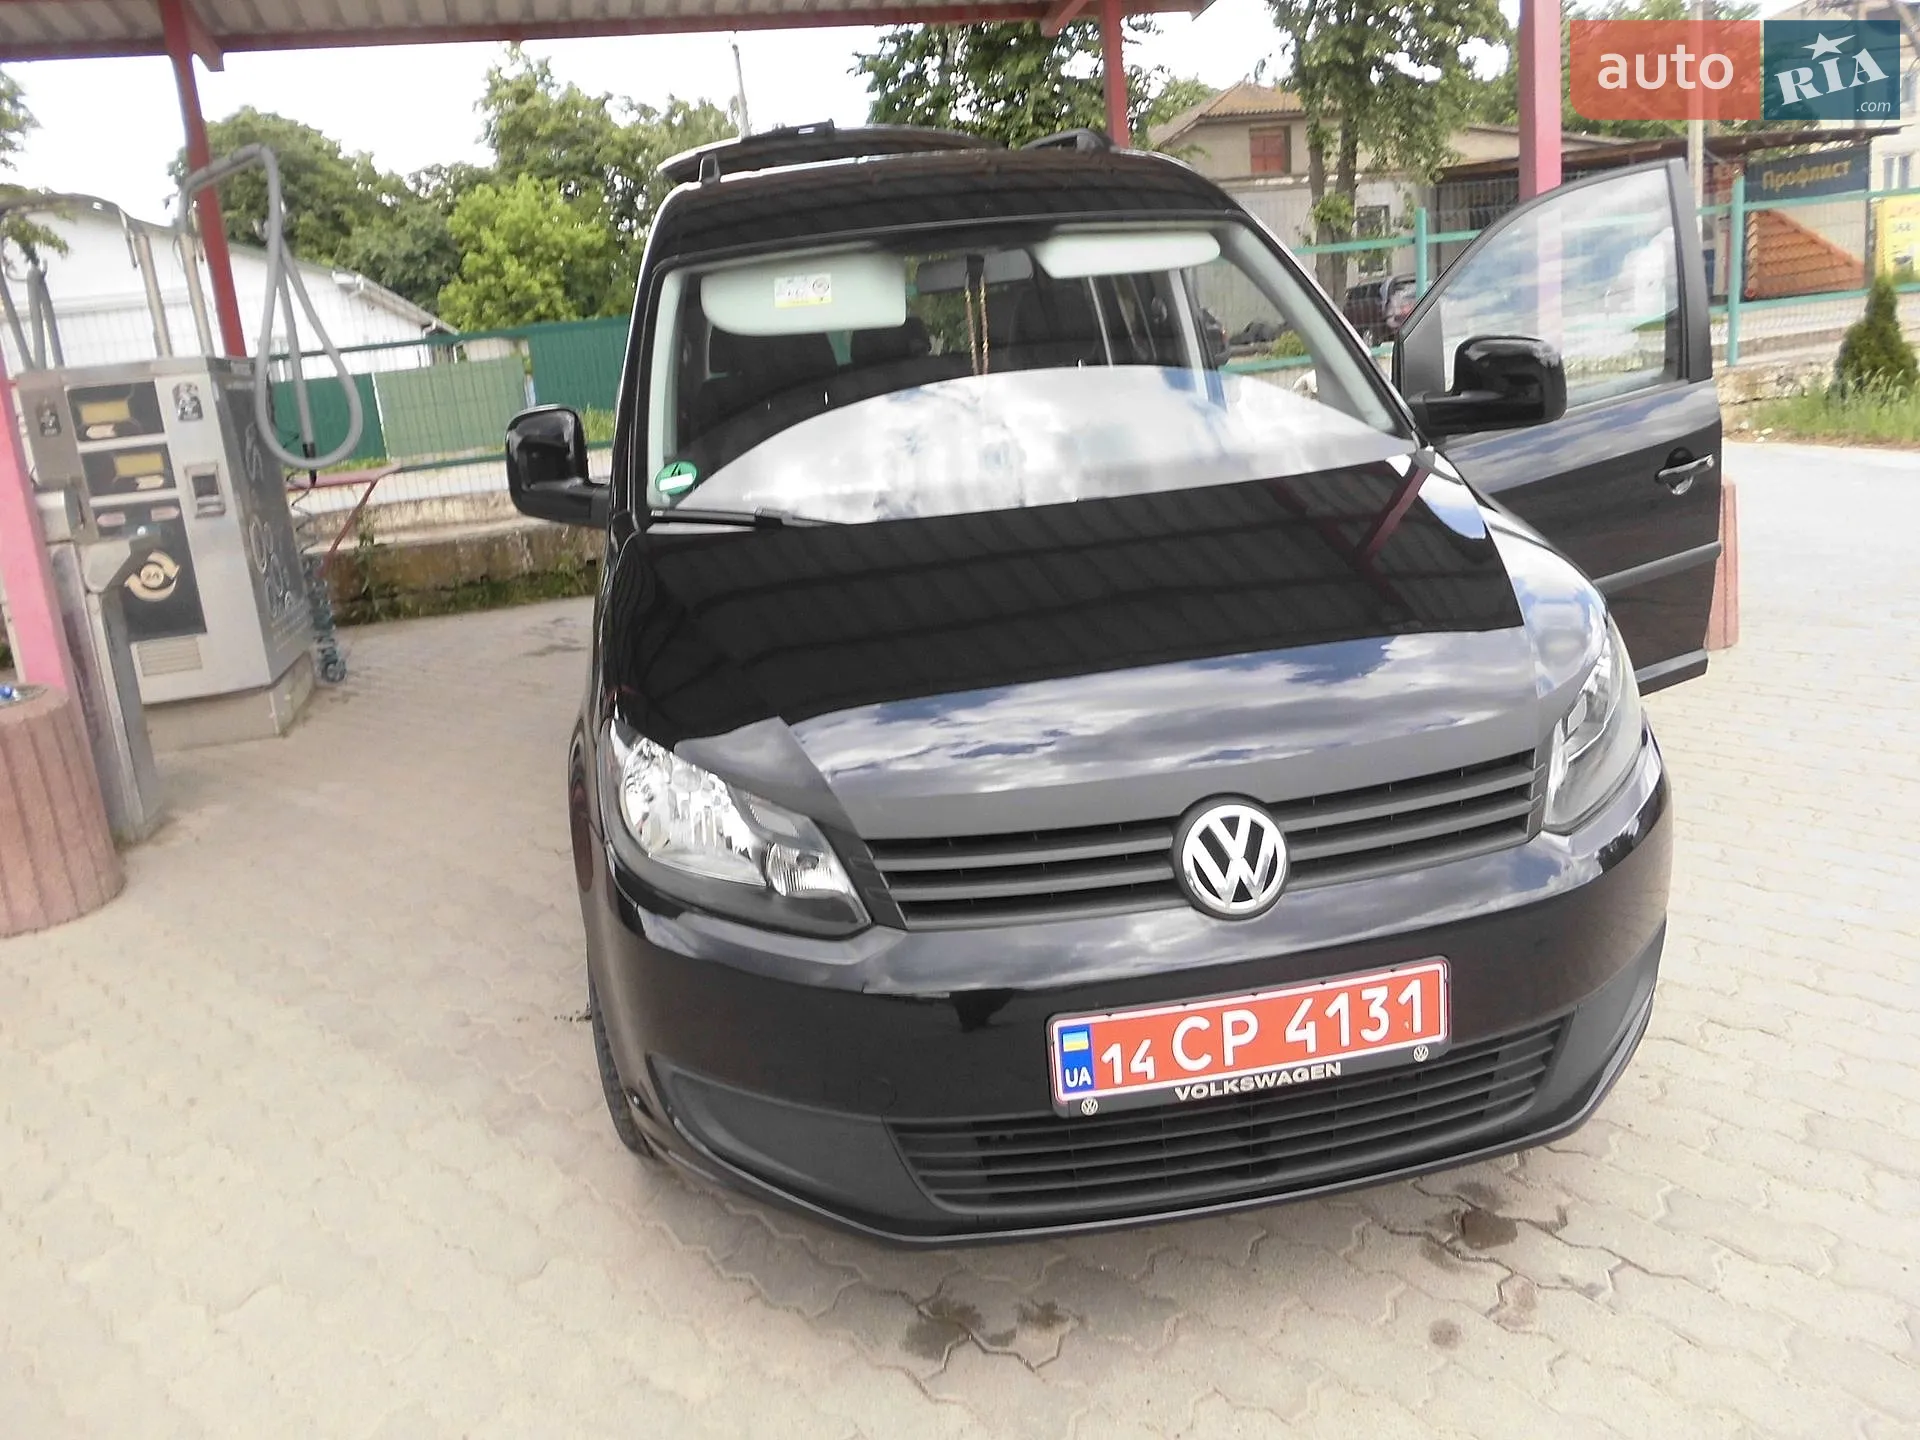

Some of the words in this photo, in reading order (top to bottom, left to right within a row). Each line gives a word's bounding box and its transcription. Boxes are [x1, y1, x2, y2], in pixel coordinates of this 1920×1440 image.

[1762, 160, 1851, 193] Профлист
[1100, 1039, 1156, 1086] 14
[1171, 1009, 1259, 1073] CP
[1284, 978, 1423, 1054] 4131
[1064, 1066, 1092, 1088] UA
[1174, 1061, 1342, 1101] VOLKSWAGEN
